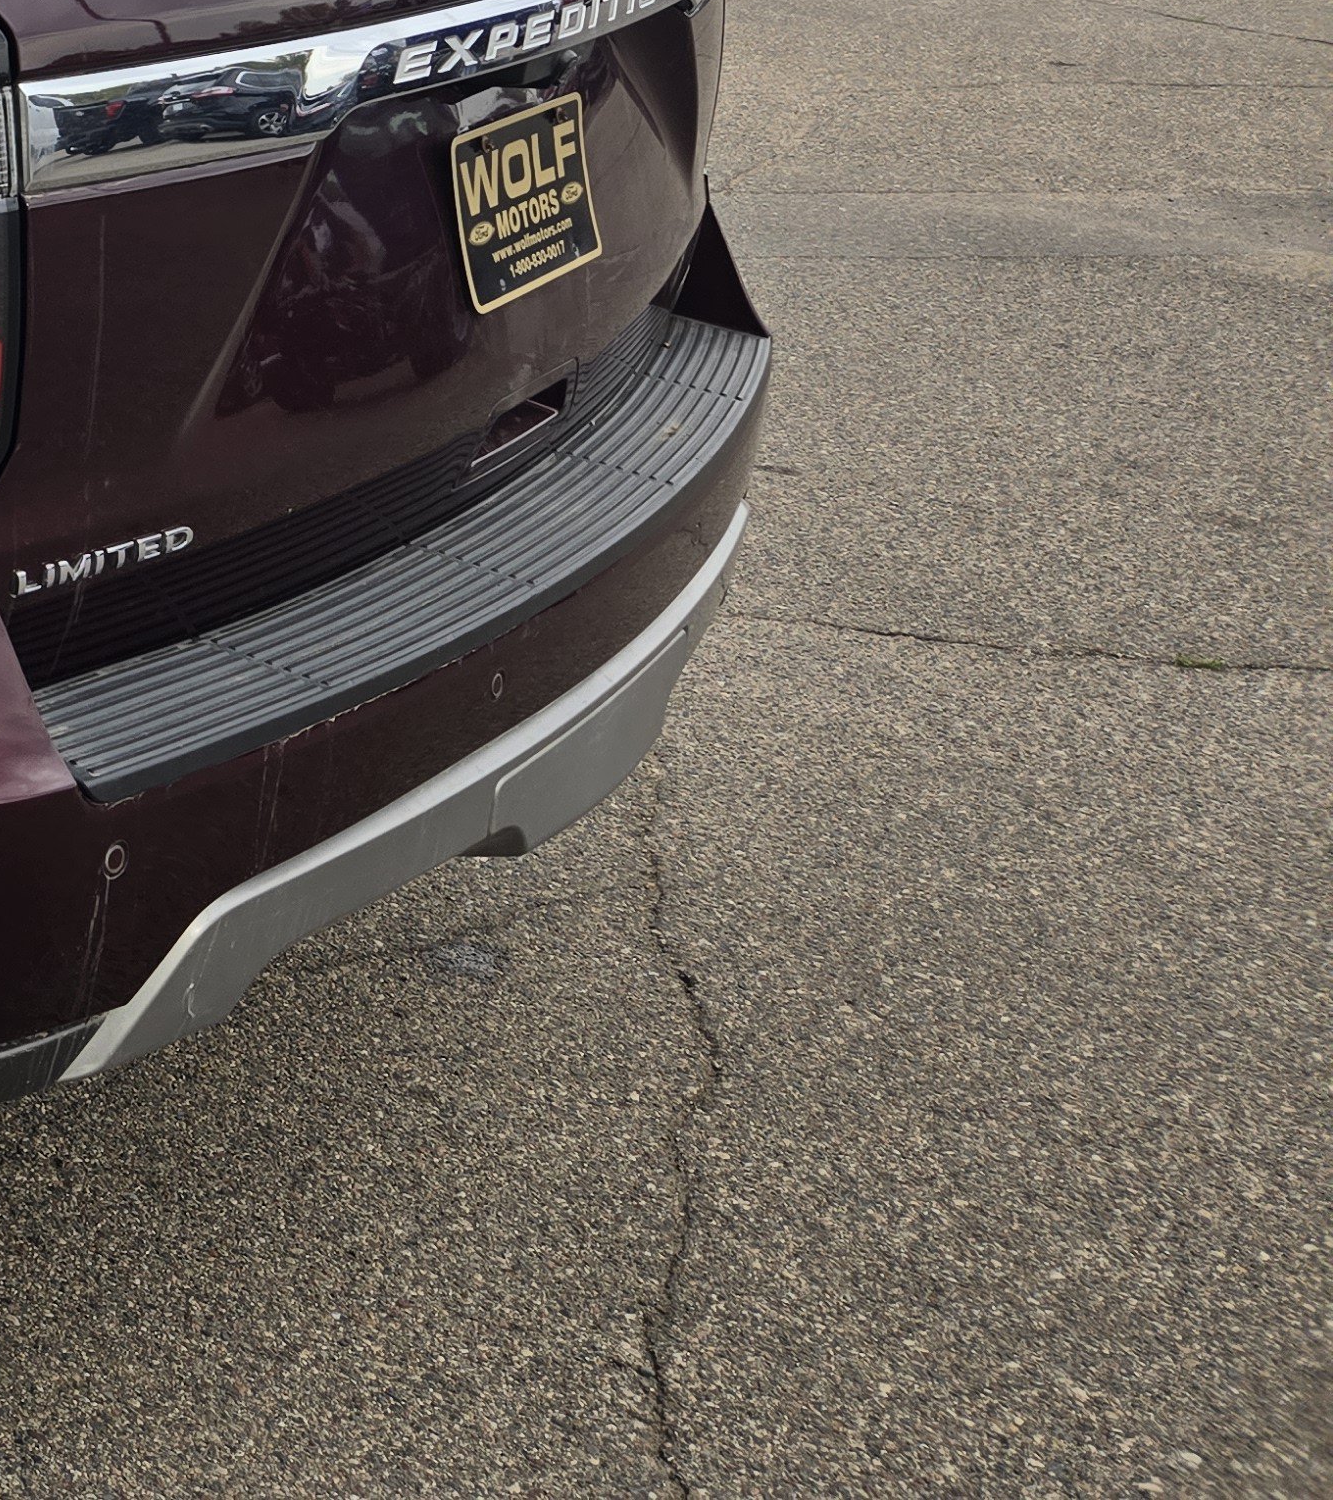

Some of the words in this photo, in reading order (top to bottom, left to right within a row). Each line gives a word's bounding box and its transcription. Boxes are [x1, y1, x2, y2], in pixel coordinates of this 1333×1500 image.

[459, 119, 577, 217] WOLF
[492, 217, 573, 264] www.wolfmotors.com
[495, 188, 561, 241] MOTORS
[509, 239, 566, 279] 1-800-830-0017
[9, 525, 195, 598] LIMITED
